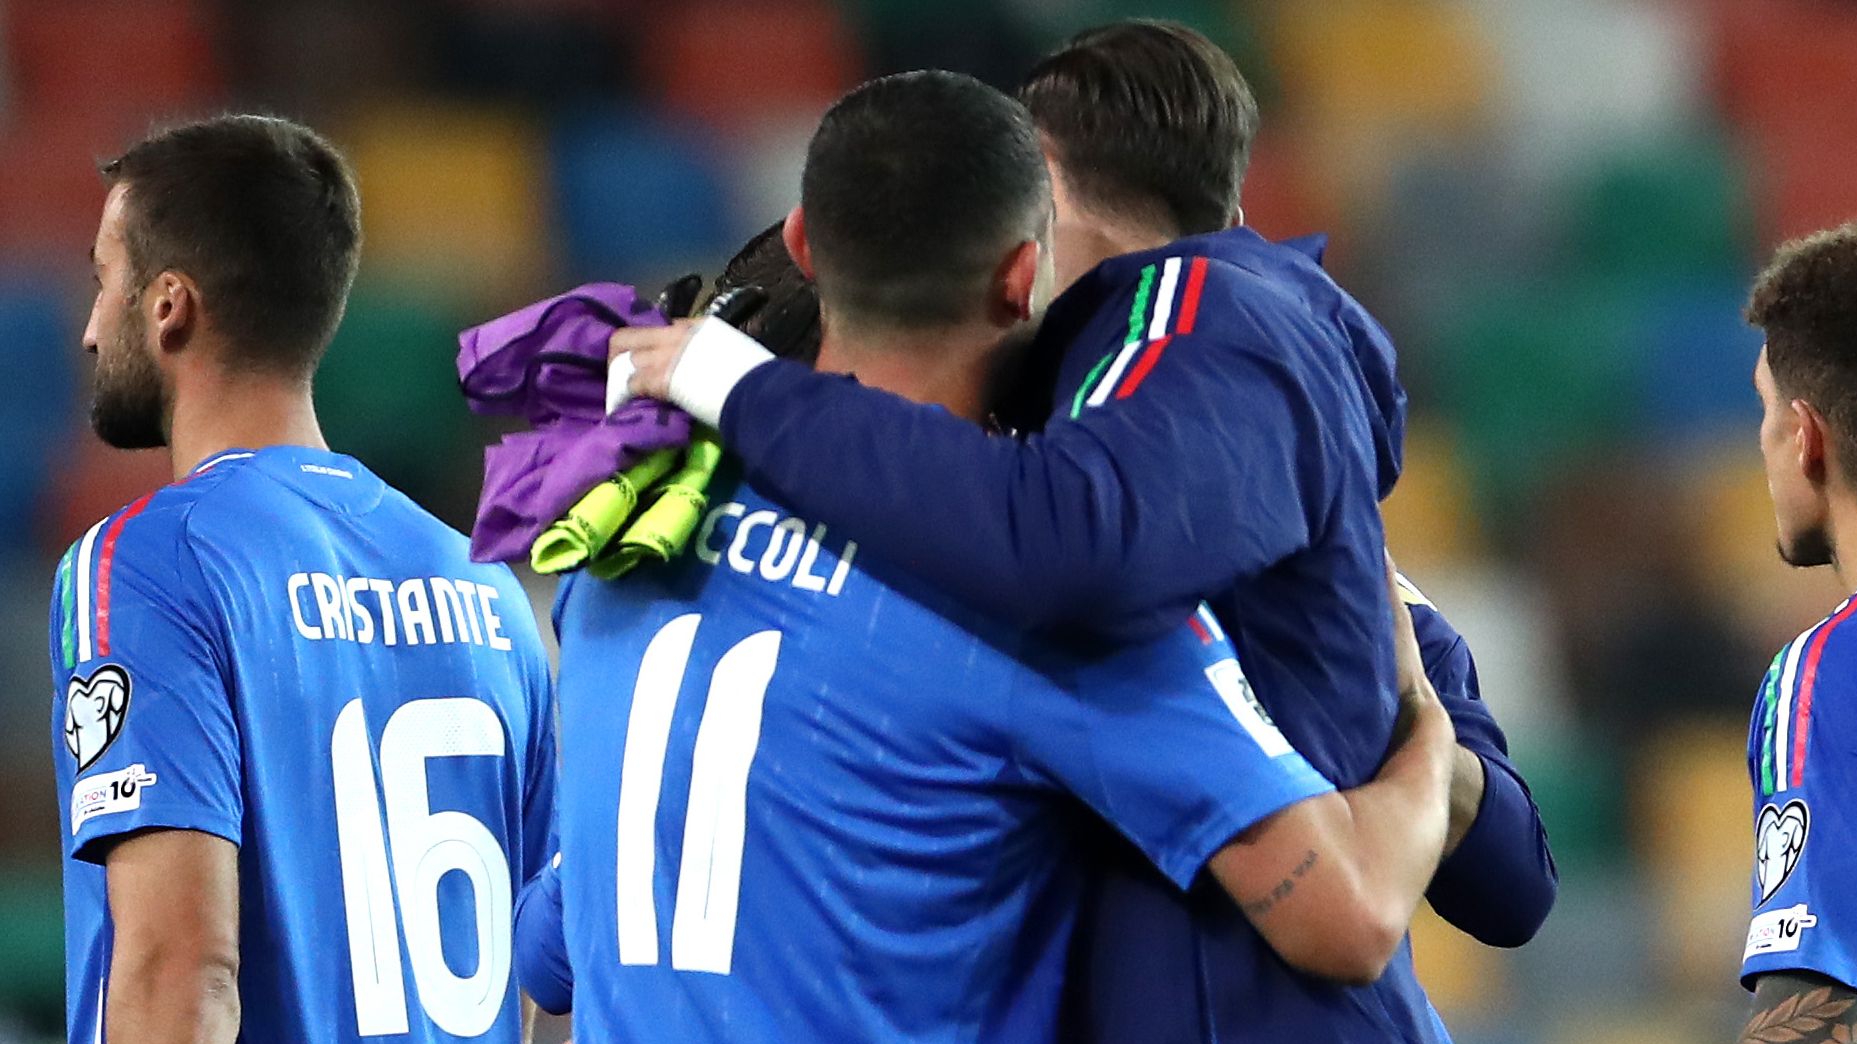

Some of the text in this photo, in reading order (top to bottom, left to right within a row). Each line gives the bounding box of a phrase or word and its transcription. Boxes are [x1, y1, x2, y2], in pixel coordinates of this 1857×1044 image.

[287, 572, 511, 651] CRISTANTE
[695, 502, 857, 596] CCOLI
[331, 697, 513, 1038] 16
[616, 613, 782, 975] 11
